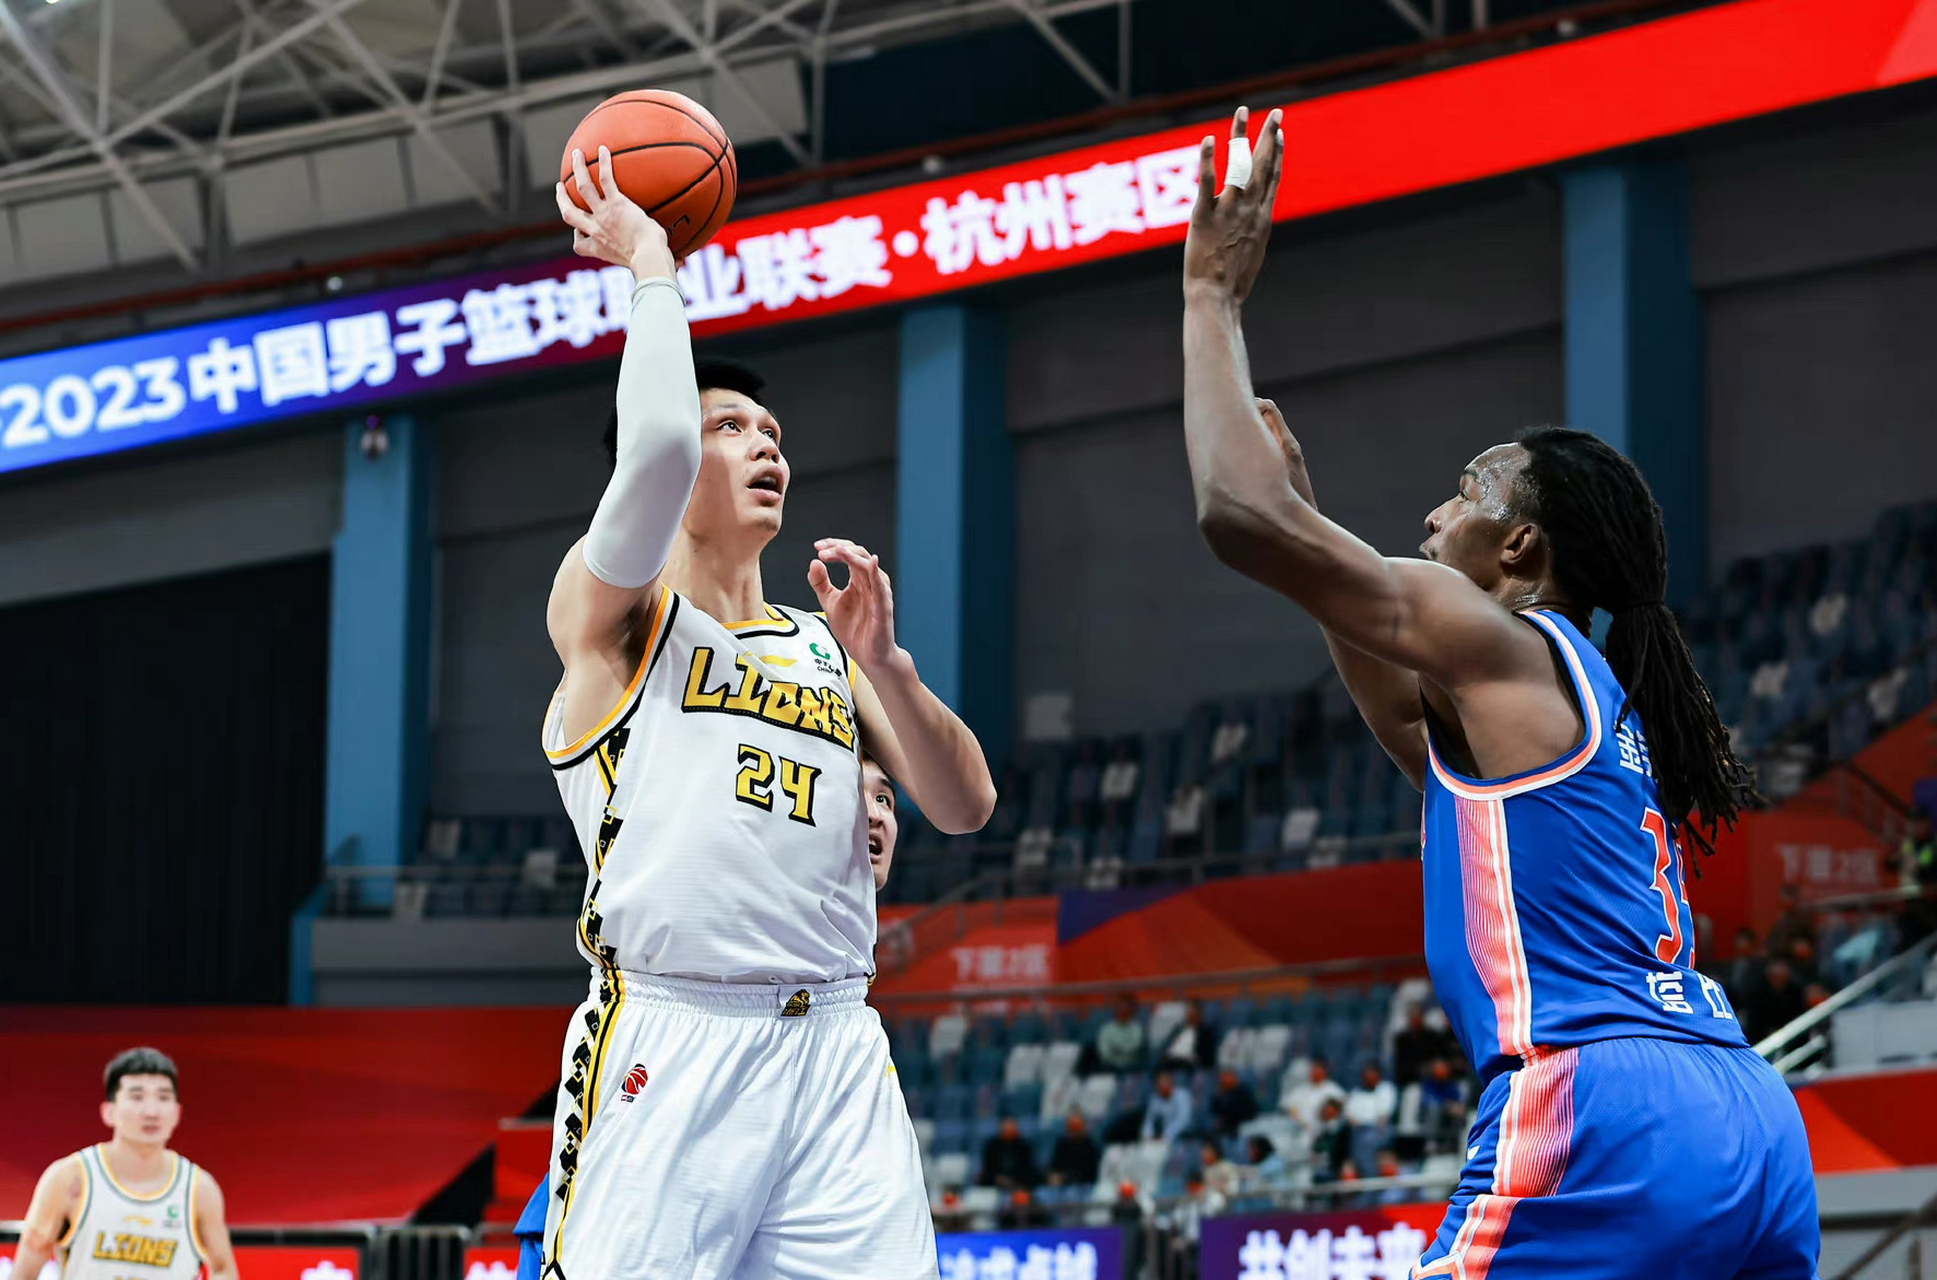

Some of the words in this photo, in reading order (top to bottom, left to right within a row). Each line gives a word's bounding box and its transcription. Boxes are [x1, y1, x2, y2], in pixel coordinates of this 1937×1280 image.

[682, 646, 856, 752] LIONS
[736, 744, 822, 827] 24
[93, 1231, 178, 1268] LIONS
